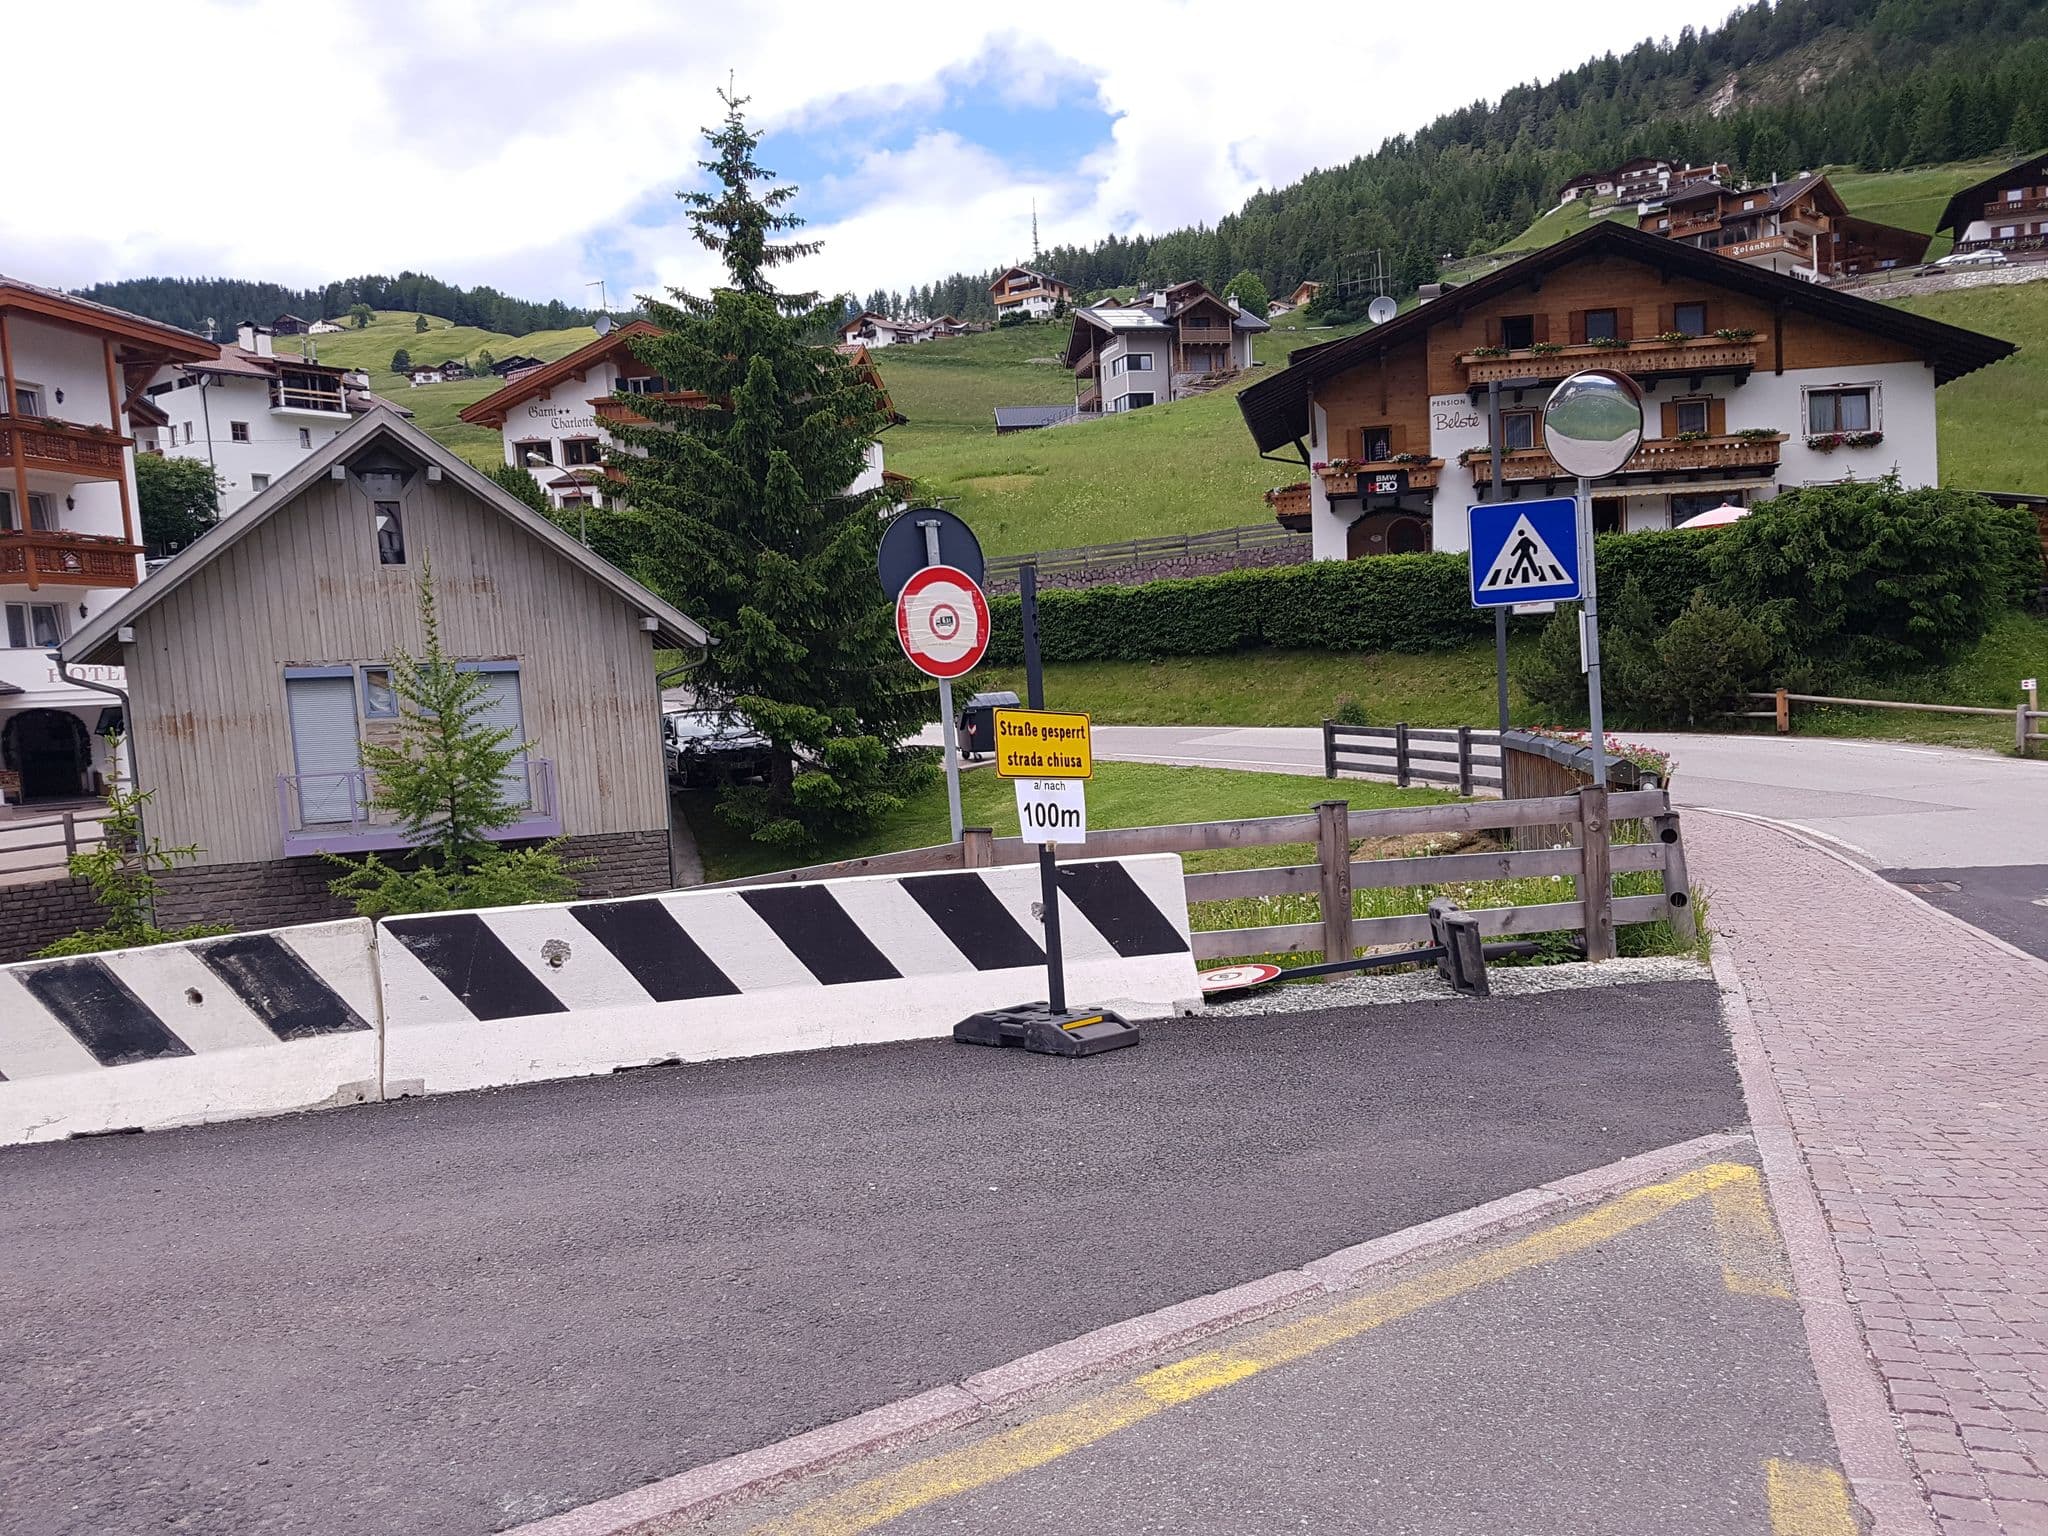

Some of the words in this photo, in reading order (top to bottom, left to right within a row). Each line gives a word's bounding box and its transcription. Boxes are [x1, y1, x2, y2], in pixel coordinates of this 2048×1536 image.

[1432, 398, 1466, 407] PENSION
[528, 405, 558, 419] Garni
[551, 416, 594, 430] Charlotte
[1376, 473, 1398, 482] BMW
[1368, 480, 1398, 493] HERO
[1000, 720, 1038, 737] Straße
[1041, 725, 1086, 742] gesperrt
[1007, 751, 1043, 767] strada
[1047, 752, 1082, 768] chiusa
[1044, 781, 1066, 791] nach
[1023, 802, 1080, 828] 100m
